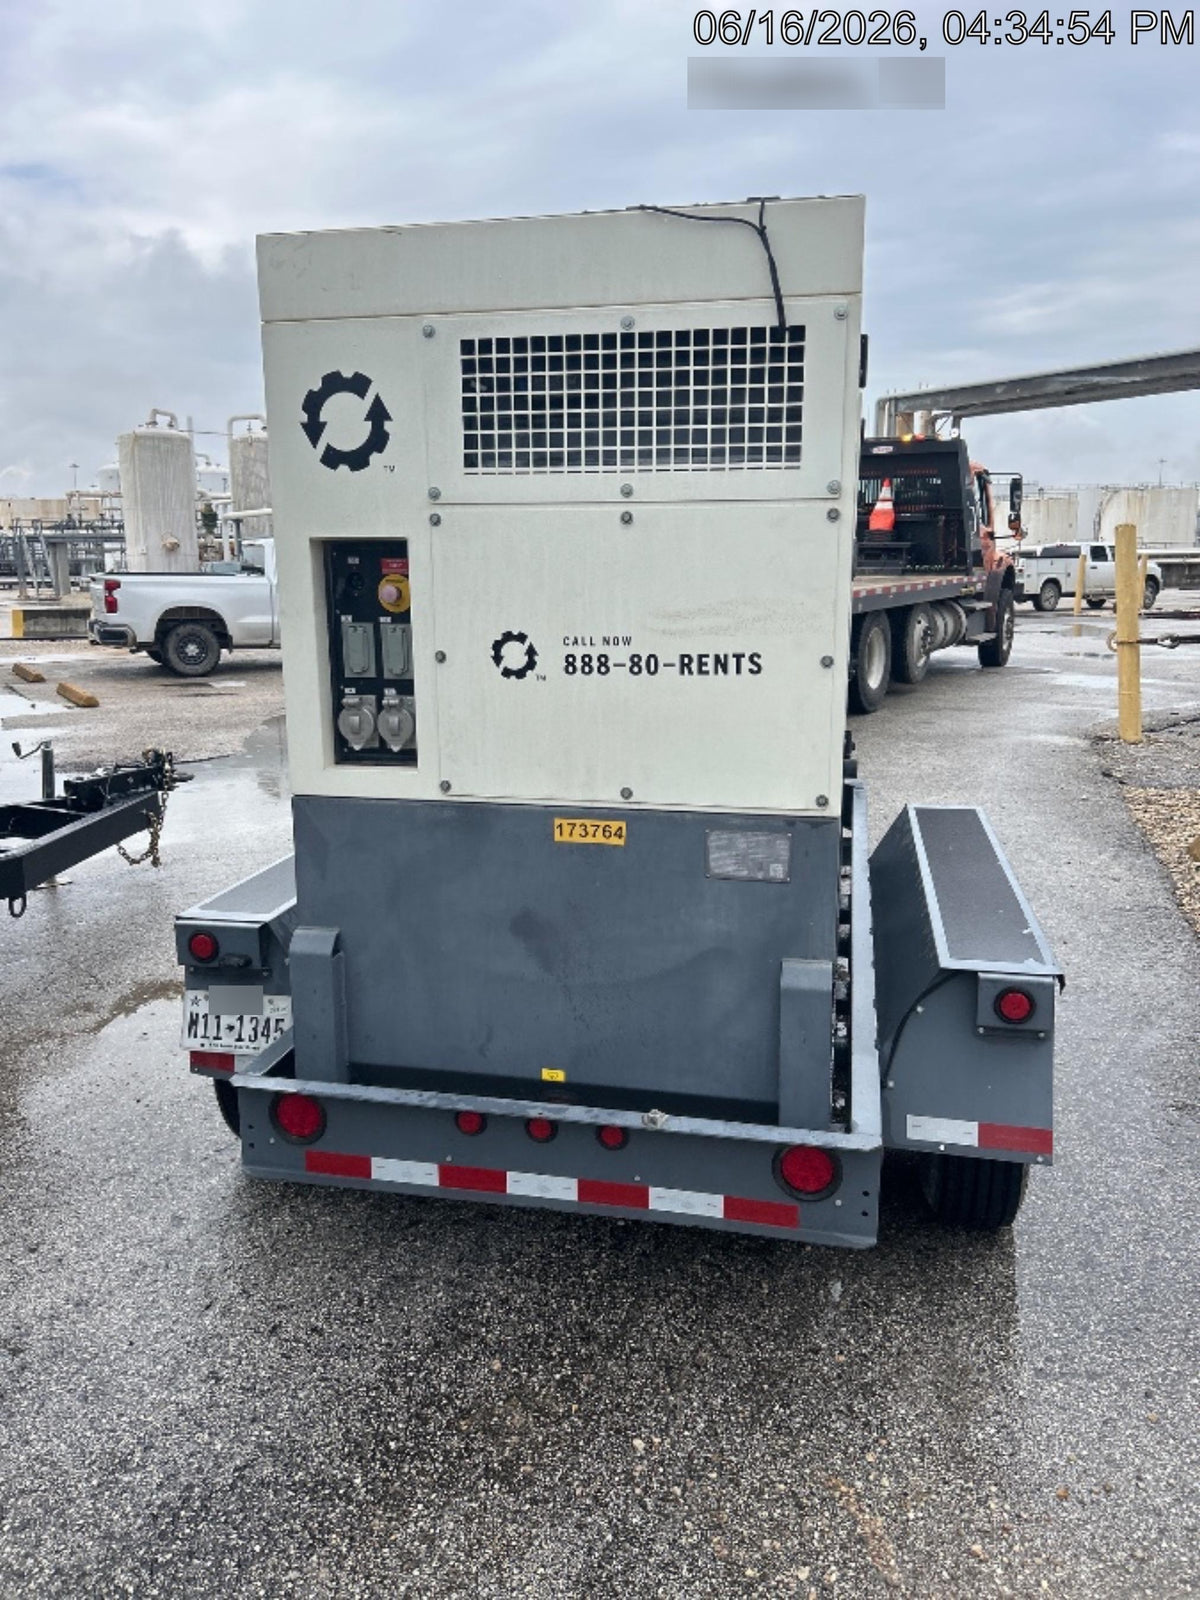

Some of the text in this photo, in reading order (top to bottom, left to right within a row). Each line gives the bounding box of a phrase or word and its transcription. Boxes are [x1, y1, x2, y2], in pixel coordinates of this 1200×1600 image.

[562, 635, 632, 647] CALL NOW
[563, 652, 763, 677] 888-80-RENTS
[555, 822, 625, 840] 173764
